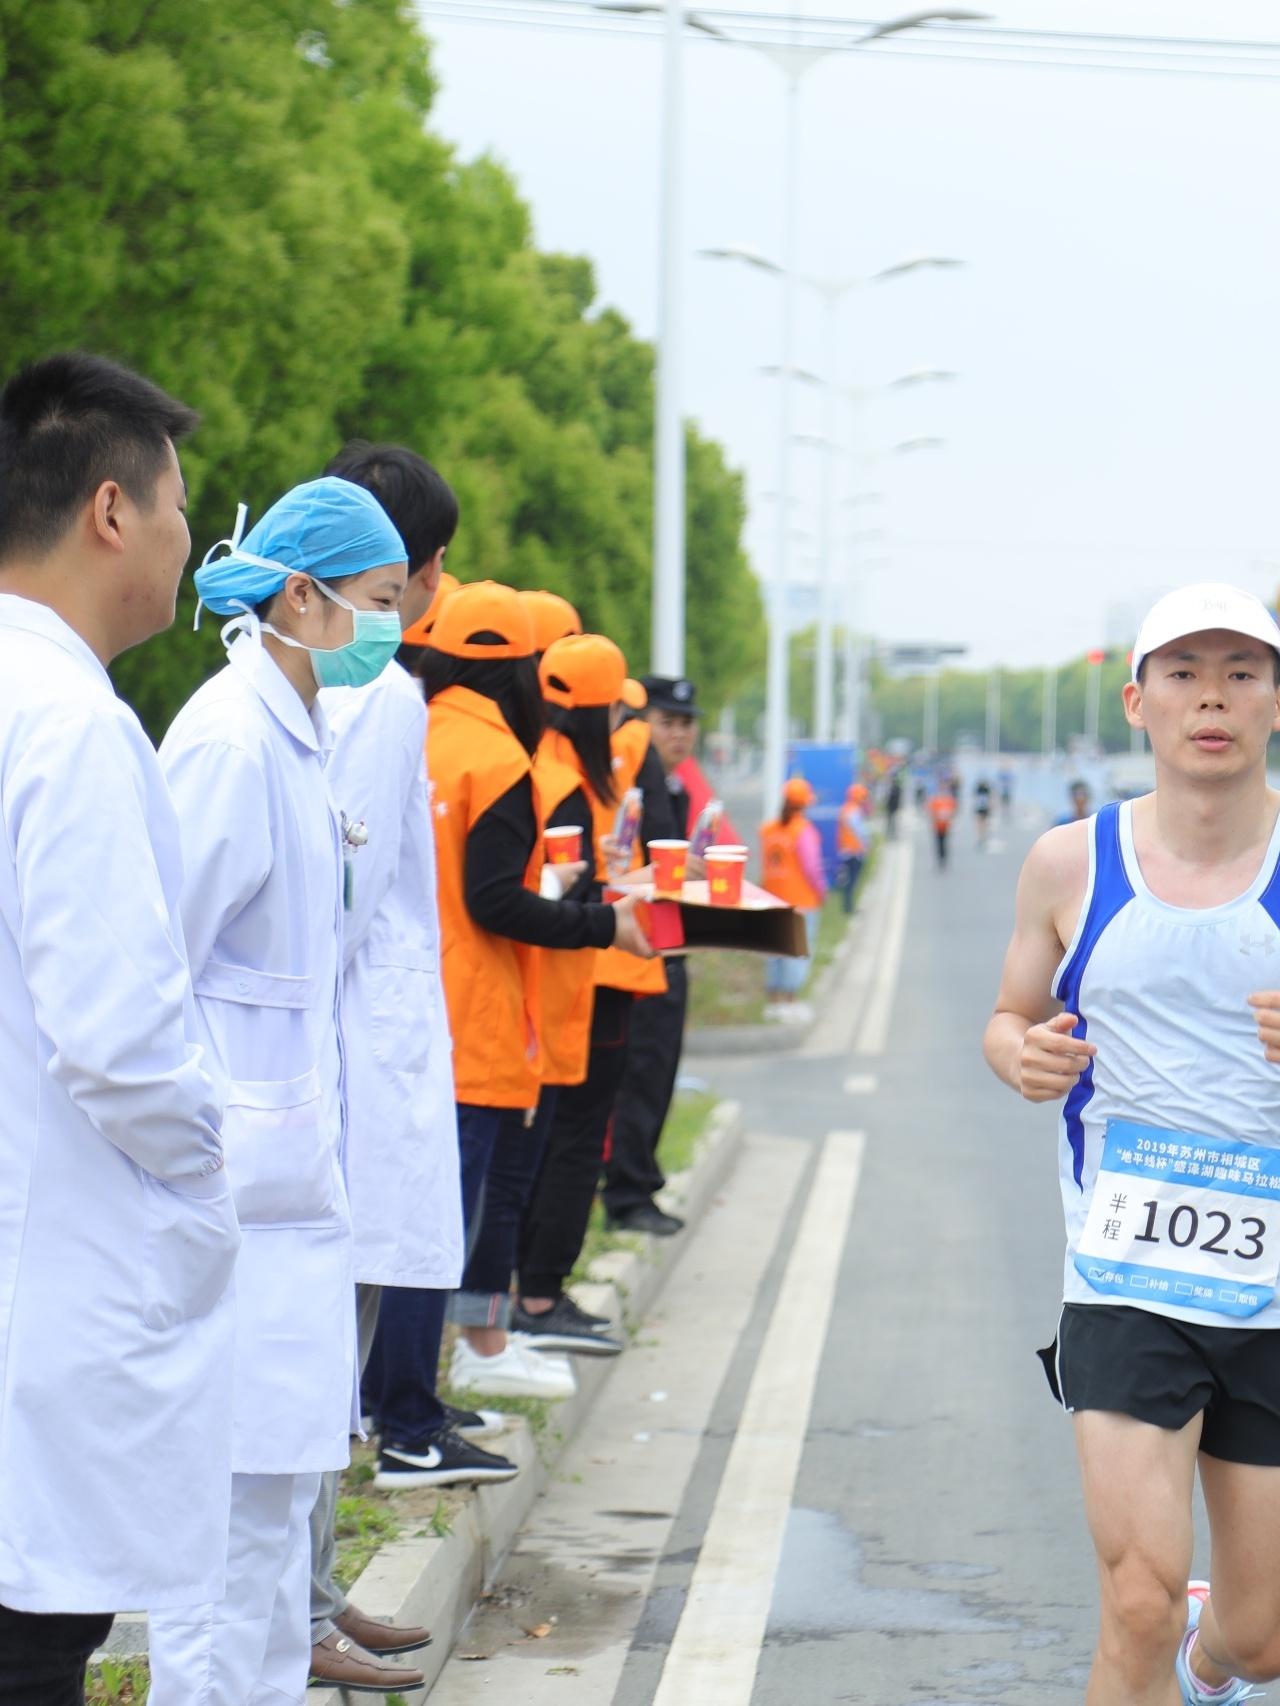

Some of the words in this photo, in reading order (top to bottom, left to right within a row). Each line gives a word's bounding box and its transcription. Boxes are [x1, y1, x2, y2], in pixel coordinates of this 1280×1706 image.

[1136, 1138, 1262, 1172] 2019年苏州市相城区
[1133, 1200, 1267, 1260] 1023
